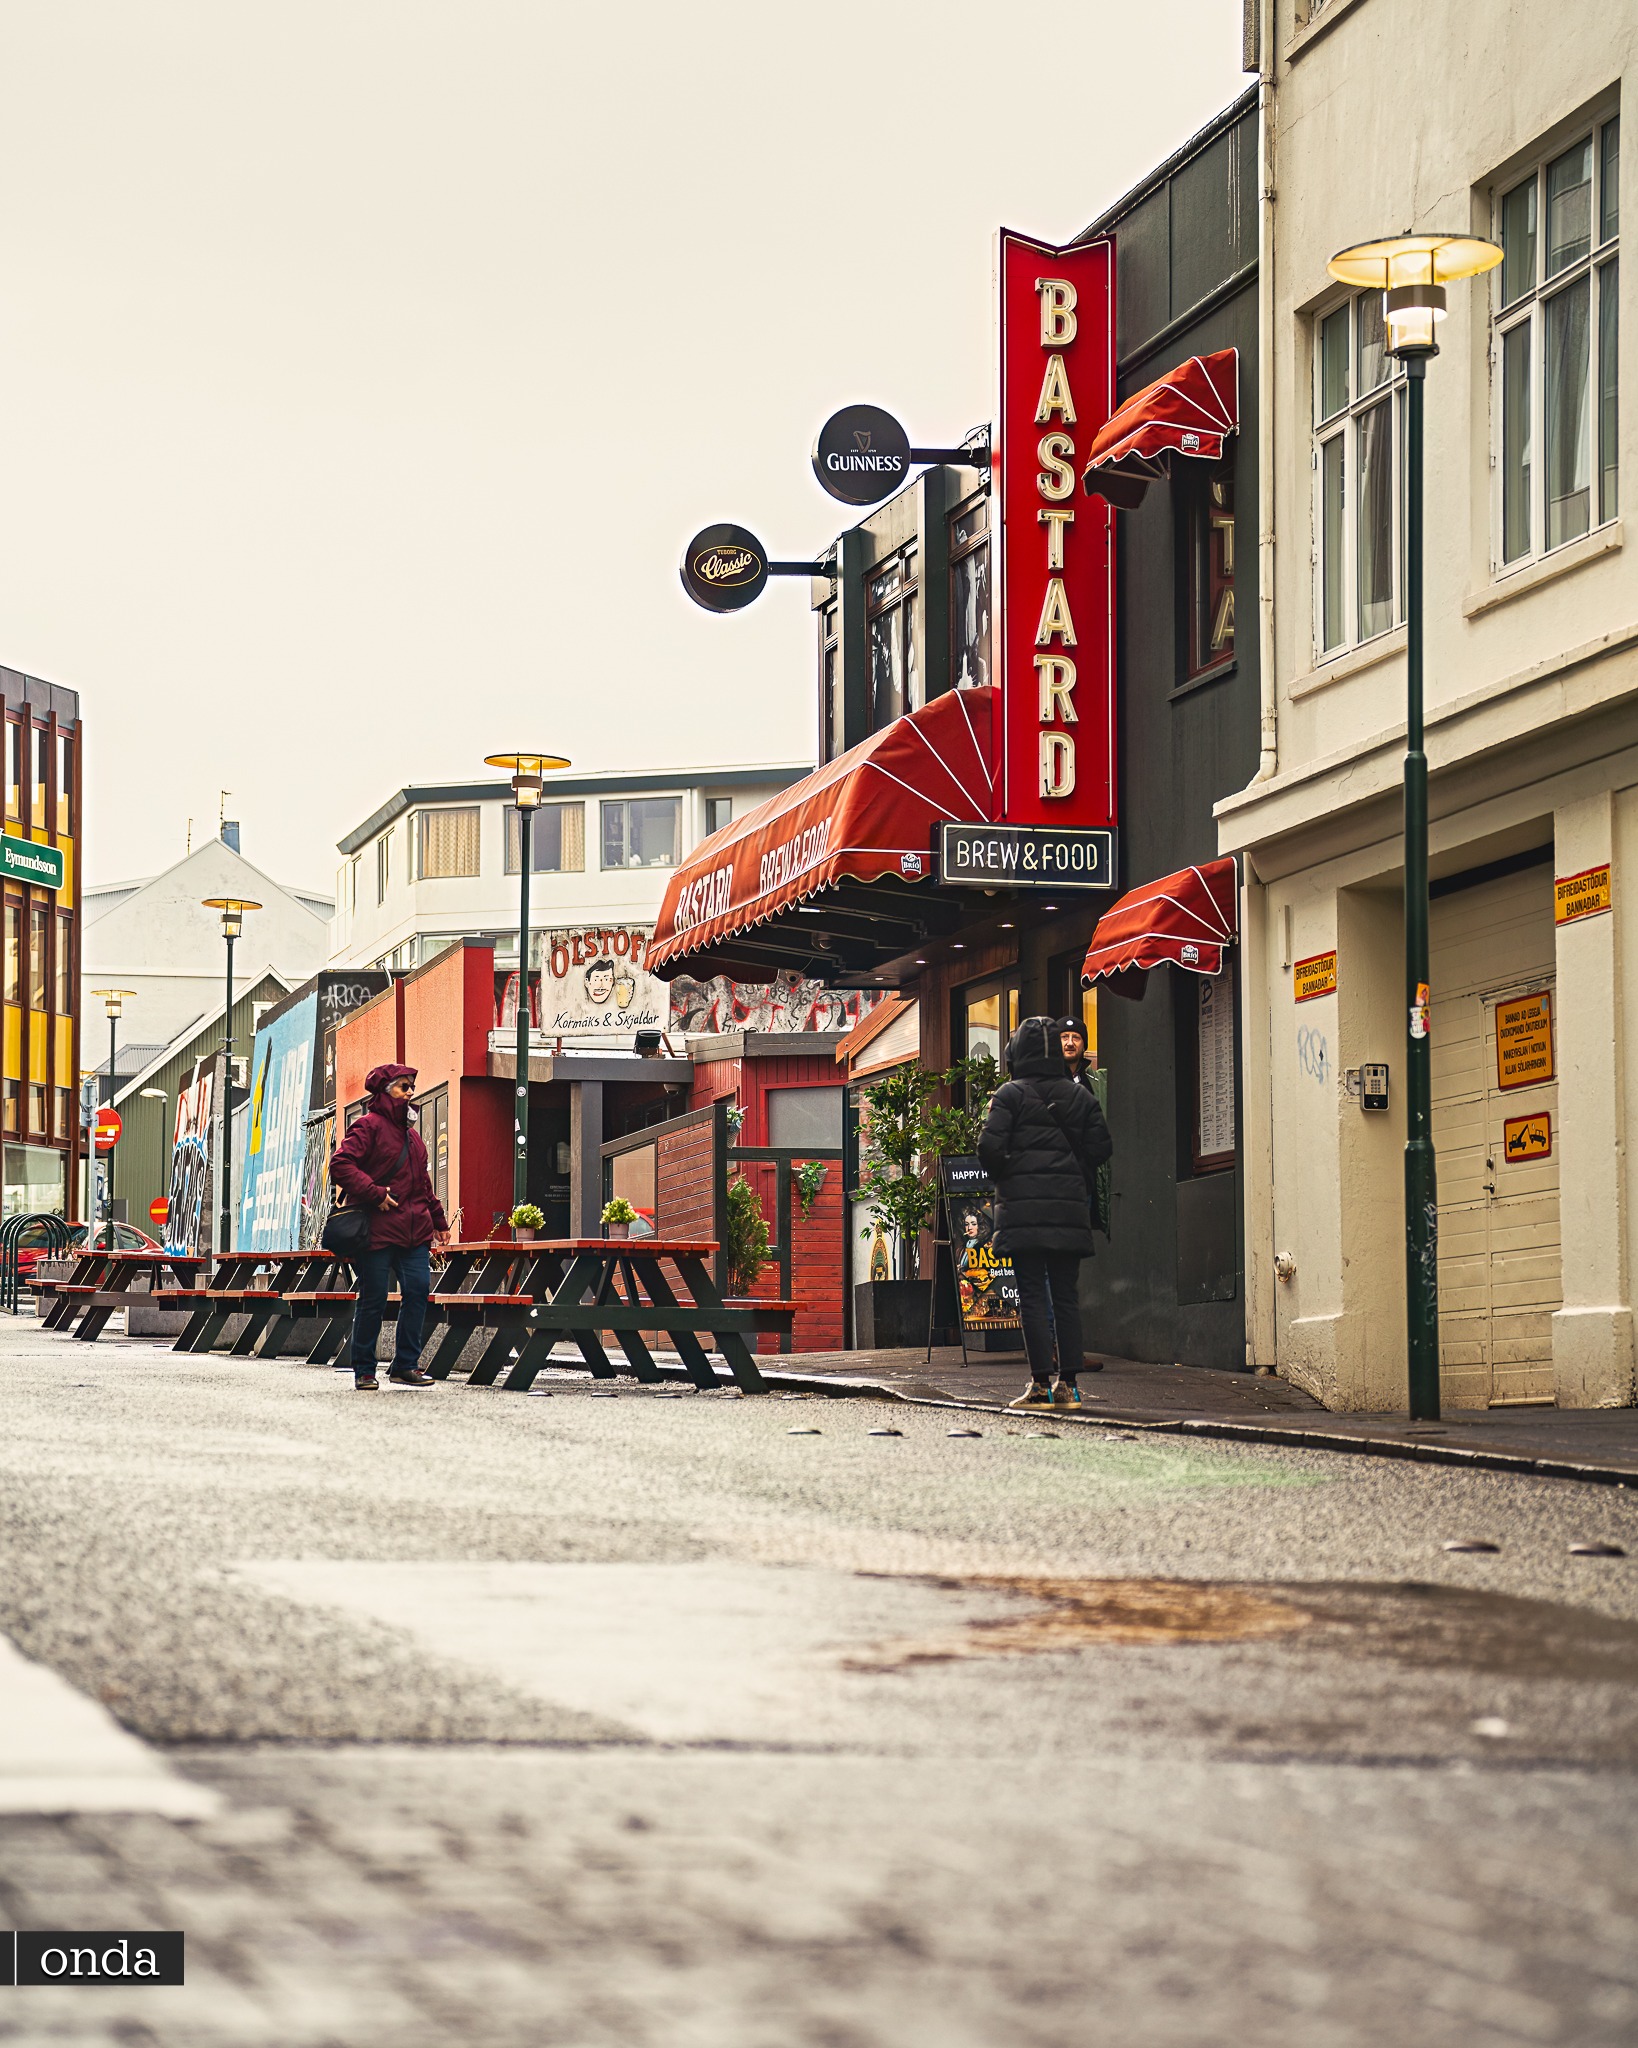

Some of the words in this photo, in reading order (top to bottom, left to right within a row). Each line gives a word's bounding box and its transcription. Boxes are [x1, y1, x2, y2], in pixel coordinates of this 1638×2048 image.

[826, 452, 902, 472] GUINNESS
[1033, 277, 1079, 798] BASTARD
[701, 552, 752, 580] Classic
[4, 847, 57, 876] Eymundsson
[673, 863, 734, 935] BASTARD
[602, 1012, 612, 1027] &
[614, 1010, 660, 1030] Skjaldar
[952, 1170, 980, 1180] HAPPY
